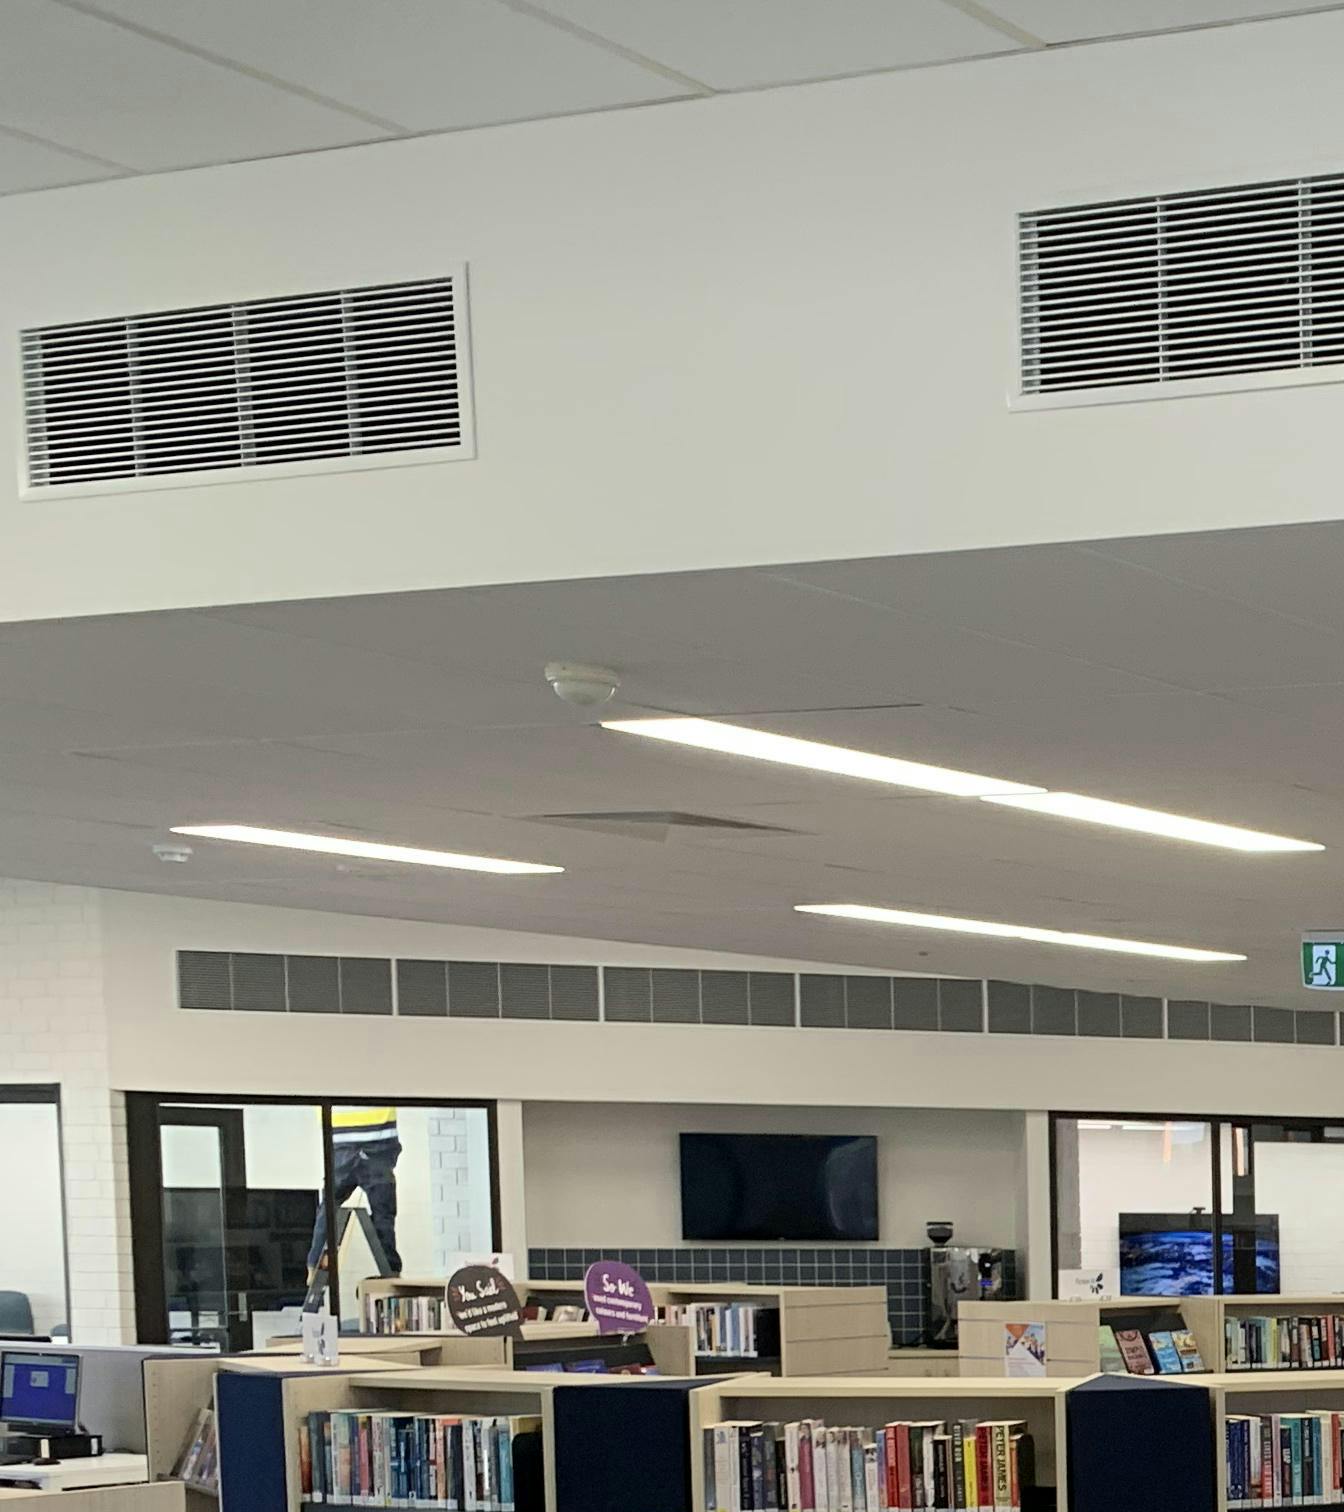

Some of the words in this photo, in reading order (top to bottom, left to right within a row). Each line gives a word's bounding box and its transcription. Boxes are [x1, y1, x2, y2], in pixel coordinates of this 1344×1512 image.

[476, 1278, 500, 1298] Said
[602, 1274, 616, 1291] So
[618, 1279, 634, 1297] We
[996, 1426, 1007, 1457] PETER
[996, 1459, 1007, 1491] JAMES
